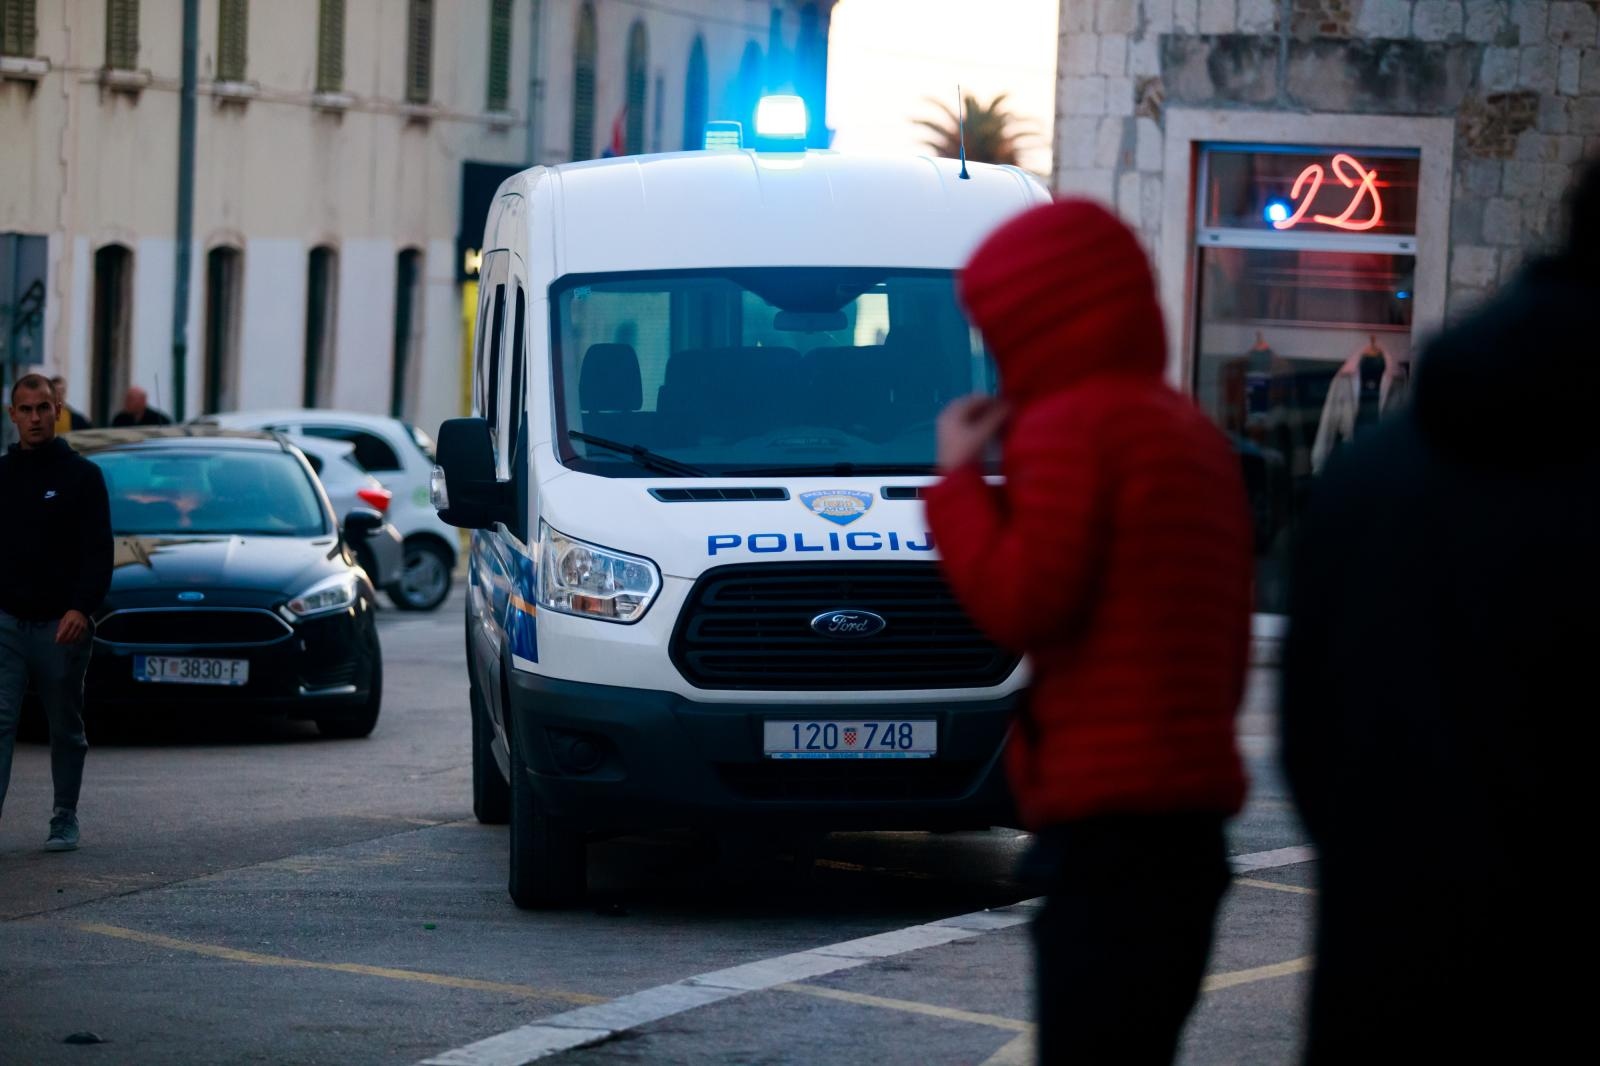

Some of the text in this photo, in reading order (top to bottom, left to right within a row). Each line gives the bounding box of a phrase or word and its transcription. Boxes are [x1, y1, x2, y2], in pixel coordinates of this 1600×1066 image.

[707, 531, 937, 556] POLICIJ
[828, 614, 868, 632] Ford
[147, 657, 168, 677] ST
[792, 722, 913, 750] 120 748
